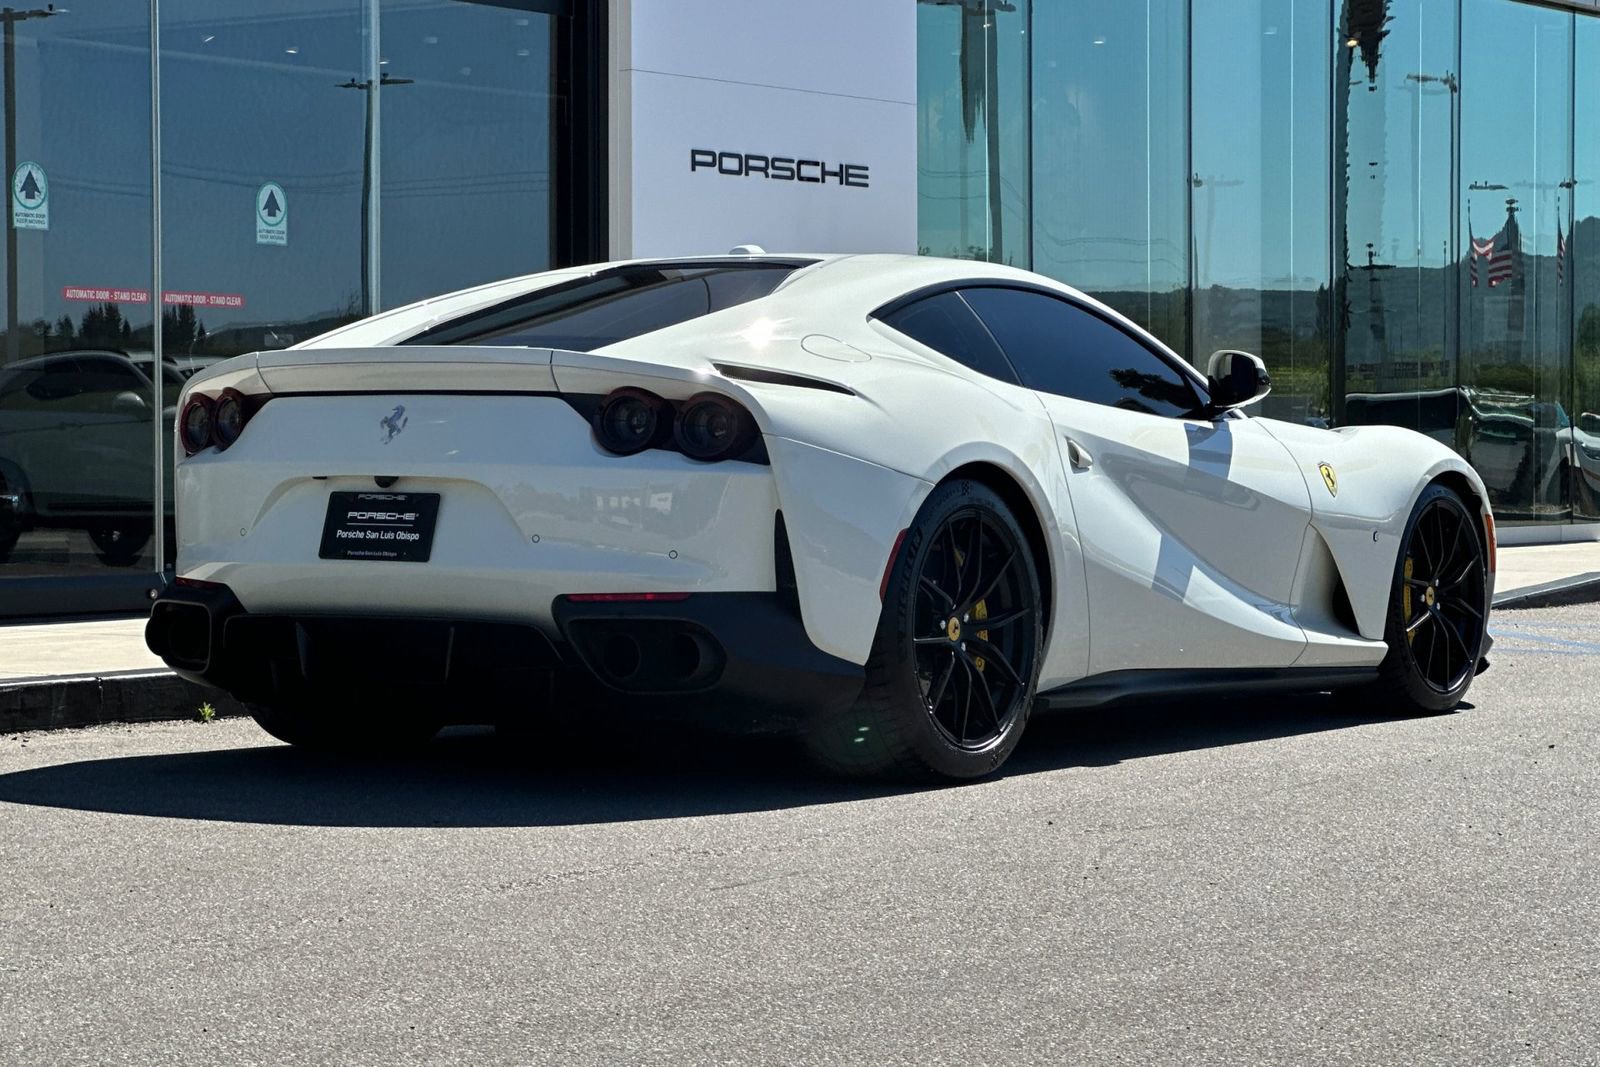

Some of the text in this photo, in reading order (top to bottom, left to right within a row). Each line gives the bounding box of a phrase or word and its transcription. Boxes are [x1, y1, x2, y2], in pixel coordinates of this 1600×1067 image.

[690, 148, 869, 188] PORSCHE
[66, 289, 95, 299] AUTOMATIC
[95, 290, 110, 300] DOOR
[114, 291, 130, 301] STAND
[131, 292, 147, 302] CLEAR
[165, 293, 193, 303] AUTOMATIC
[193, 294, 206, 304] DOOR
[210, 295, 225, 305] STAND
[226, 296, 241, 306] CLEAR
[358, 493, 406, 501] PORSCHE
[347, 511, 416, 520] PORSCHE
[336, 530, 420, 542] Porsche San Luis Obispo
